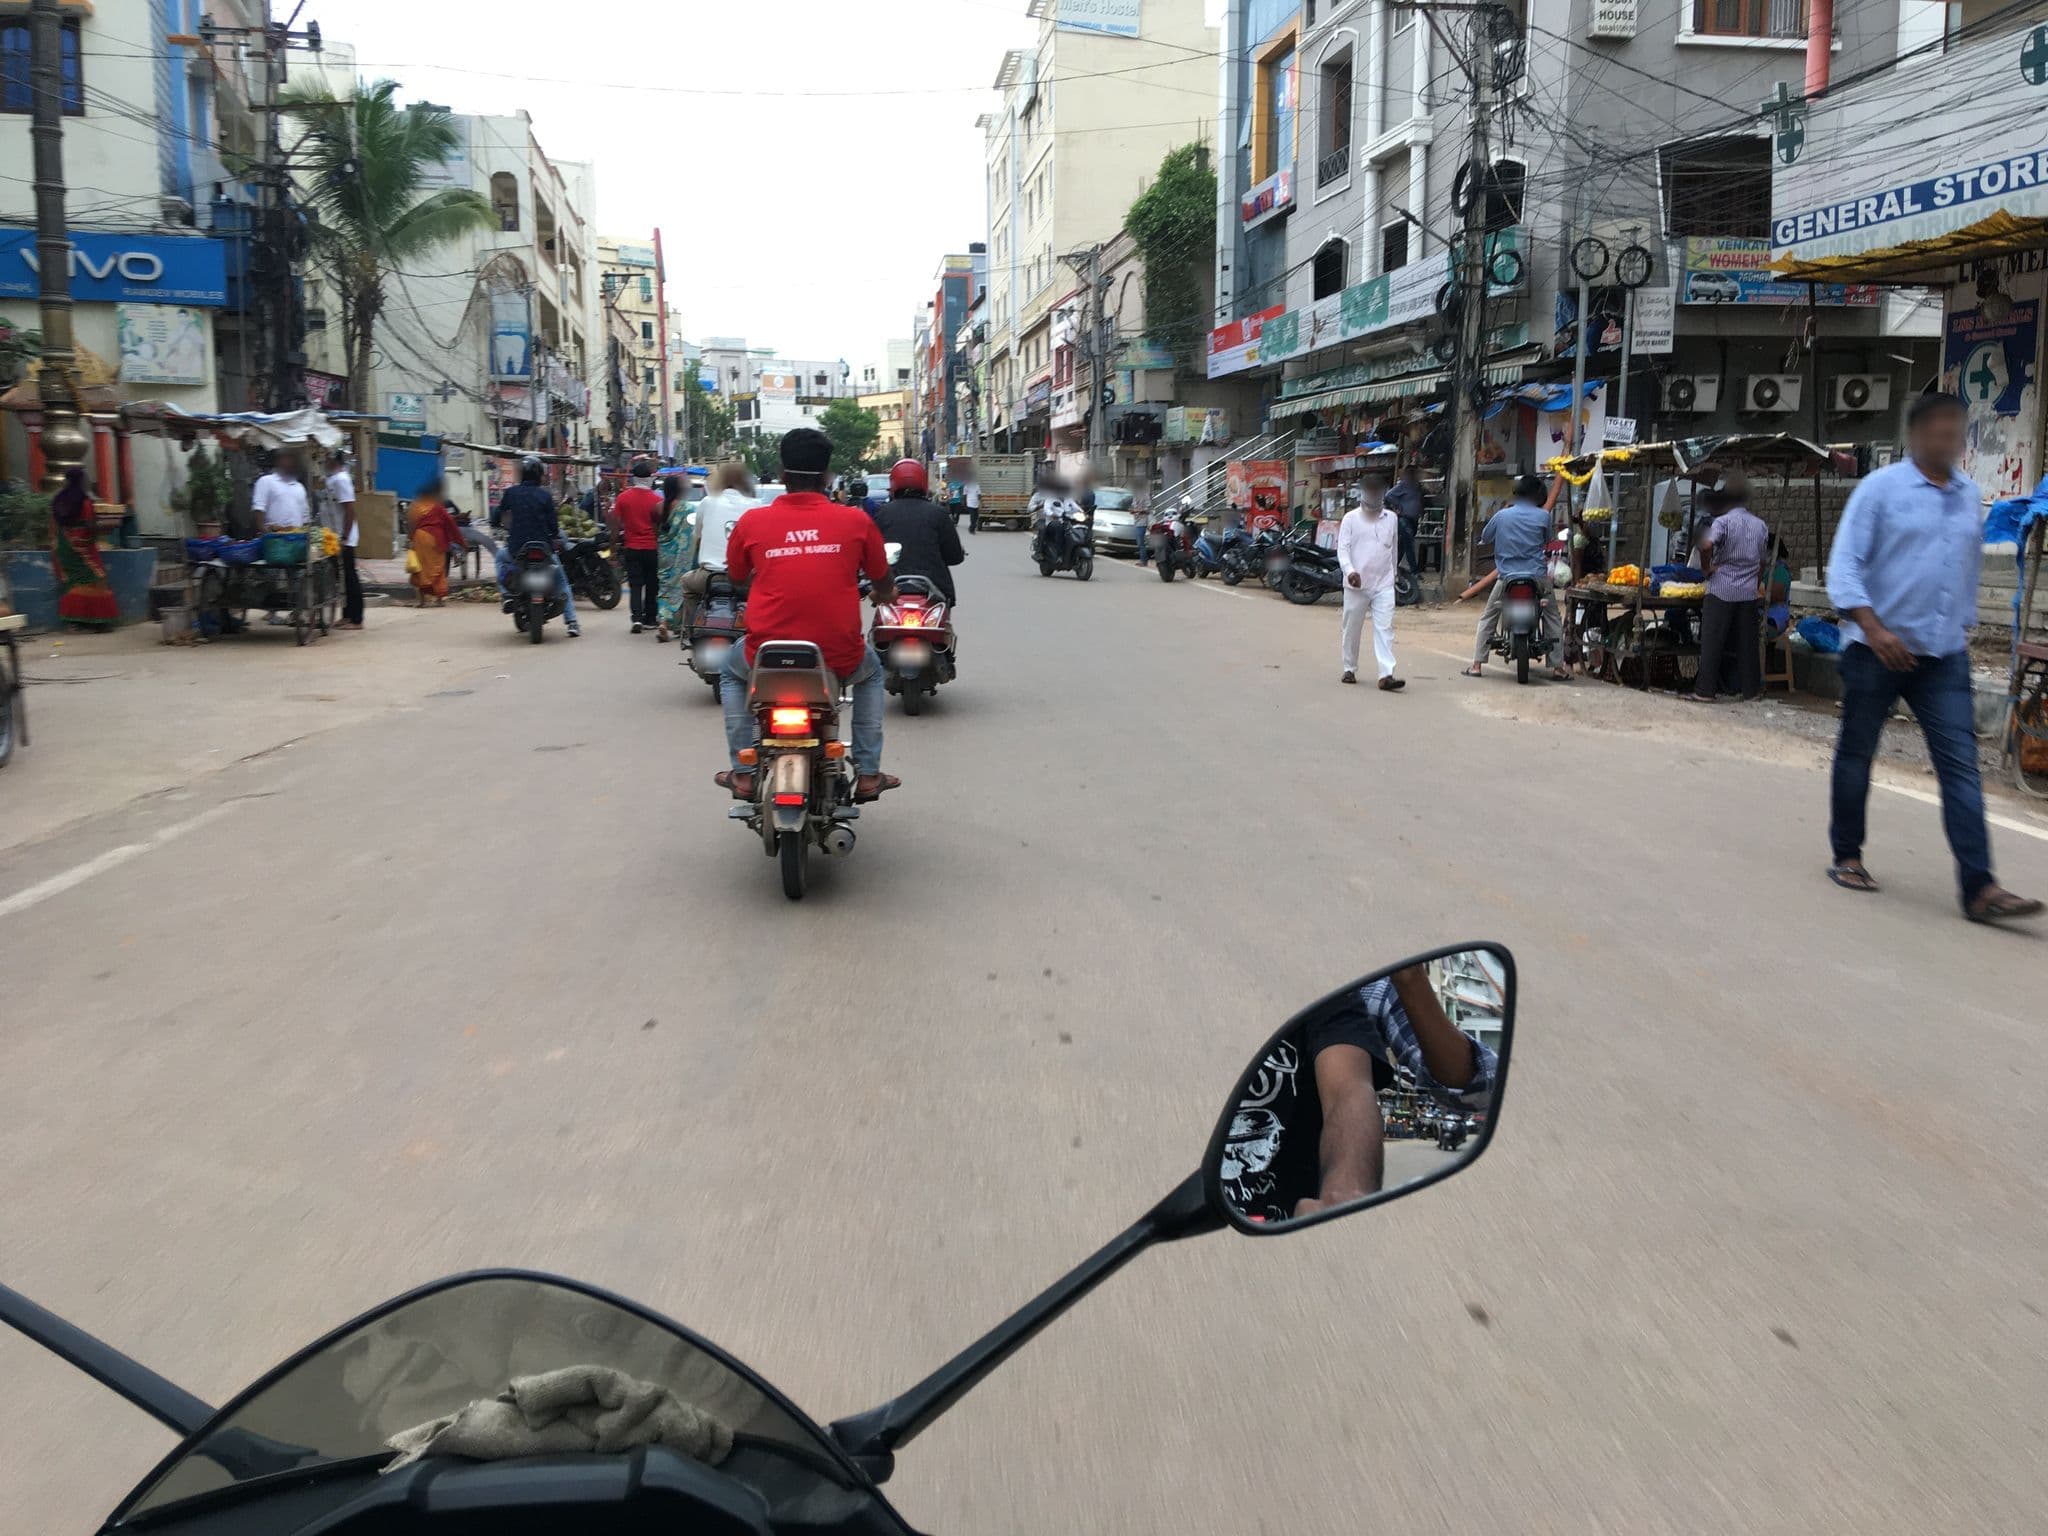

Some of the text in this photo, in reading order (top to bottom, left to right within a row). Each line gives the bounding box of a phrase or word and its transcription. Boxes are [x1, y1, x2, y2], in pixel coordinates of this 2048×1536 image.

[1599, 10, 1635, 20] HOUSE
[1775, 187, 1922, 246] GENERAL
[784, 529, 820, 543] AVR
[765, 543, 842, 559] CHICKEN MARKET
